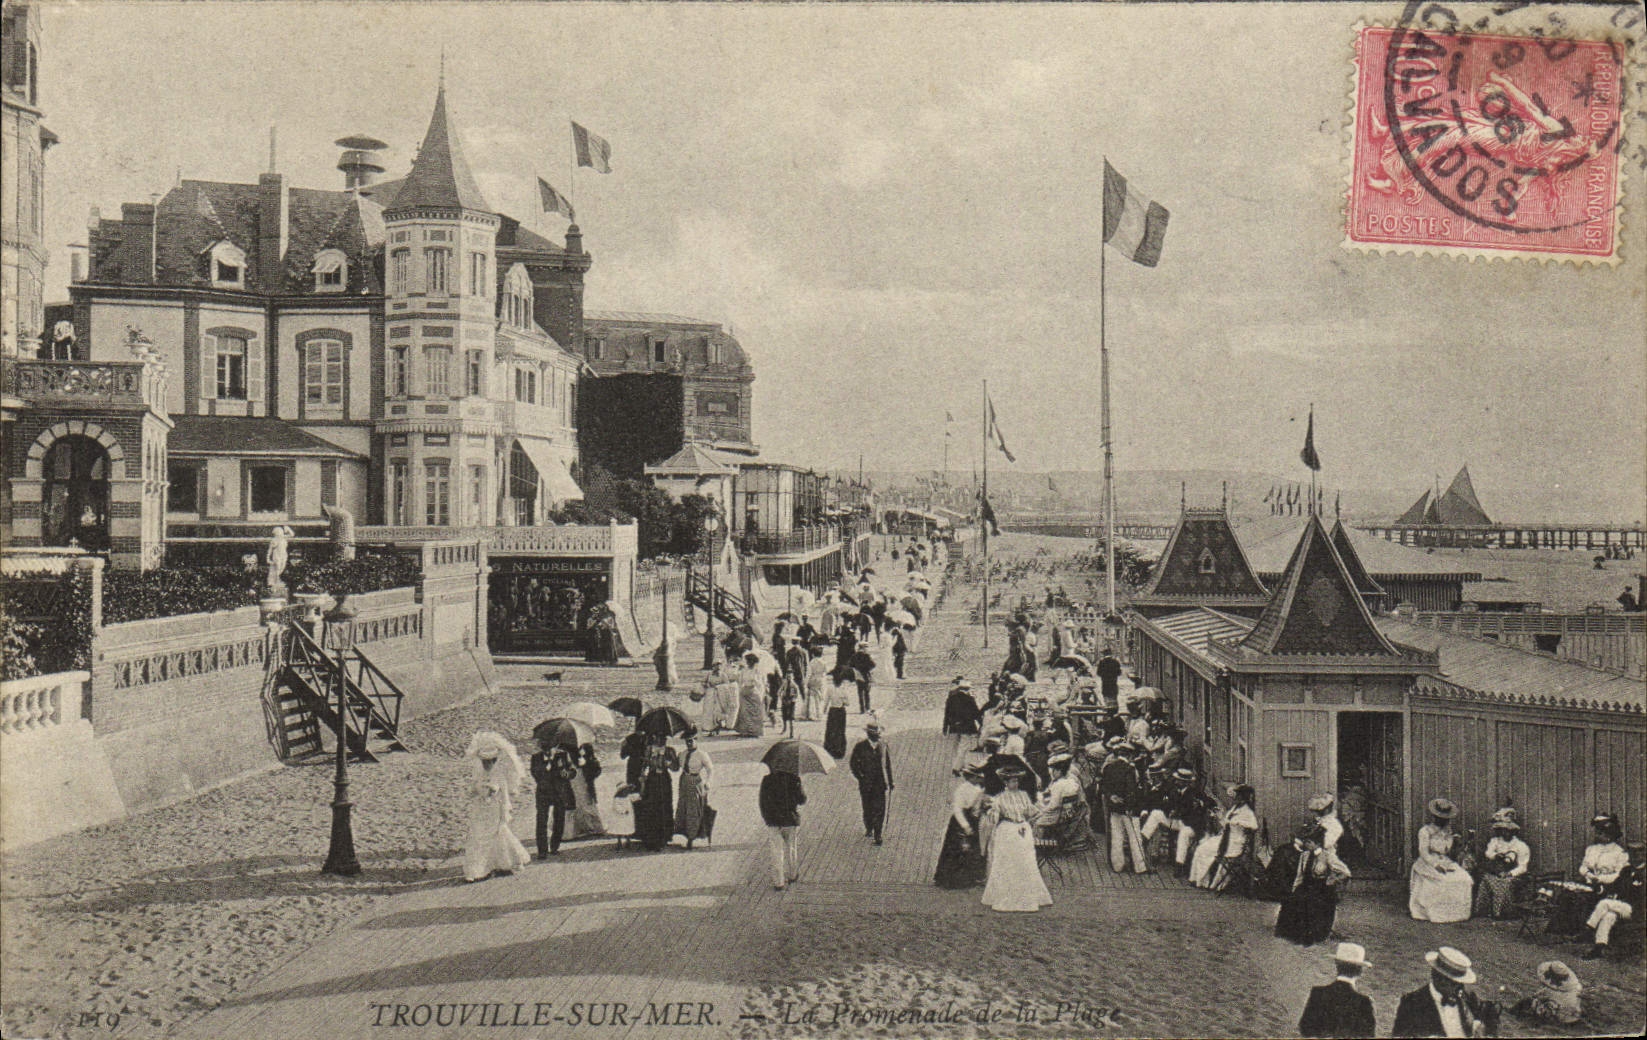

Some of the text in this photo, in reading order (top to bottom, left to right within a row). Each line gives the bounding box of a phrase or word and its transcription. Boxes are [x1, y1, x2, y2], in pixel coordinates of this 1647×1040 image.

[1402, 3, 1518, 217] CALVADOS
[1368, 214, 1451, 236] POSTES
[512, 562, 602, 571] NATURELLES
